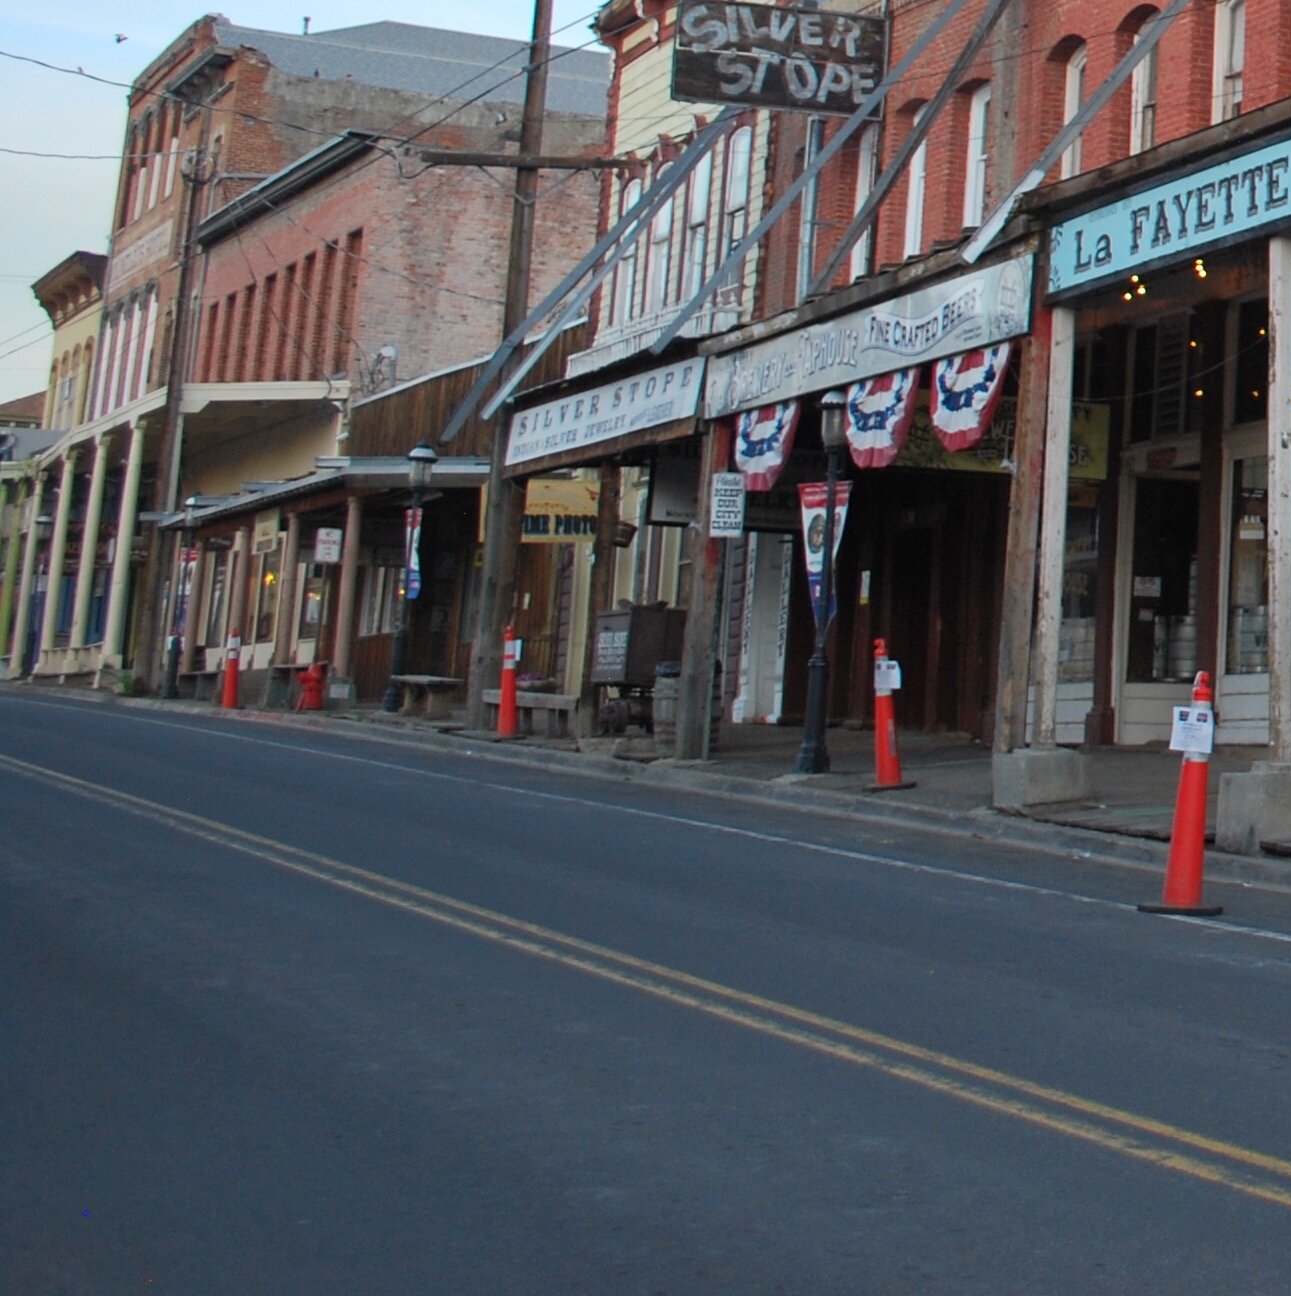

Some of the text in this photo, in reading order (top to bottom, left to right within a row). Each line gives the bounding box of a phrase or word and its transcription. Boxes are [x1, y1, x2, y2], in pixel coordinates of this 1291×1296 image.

[682, 3, 862, 58] SILVER
[716, 46, 876, 104] STOPE
[1073, 229, 1112, 275] La
[1130, 155, 1290, 256] FAYETTE
[869, 315, 891, 346] FINE
[893, 315, 939, 347] CRAFTED
[941, 288, 978, 333] BEERS
[517, 394, 600, 436] SILVER
[612, 365, 693, 409] STOPE
[544, 428, 578, 451] SILVER
[714, 487, 743, 497] KEEP
[718, 498, 739, 508] OUR
[712, 520, 742, 530] CLEAN
[716, 509, 741, 519] CITY
